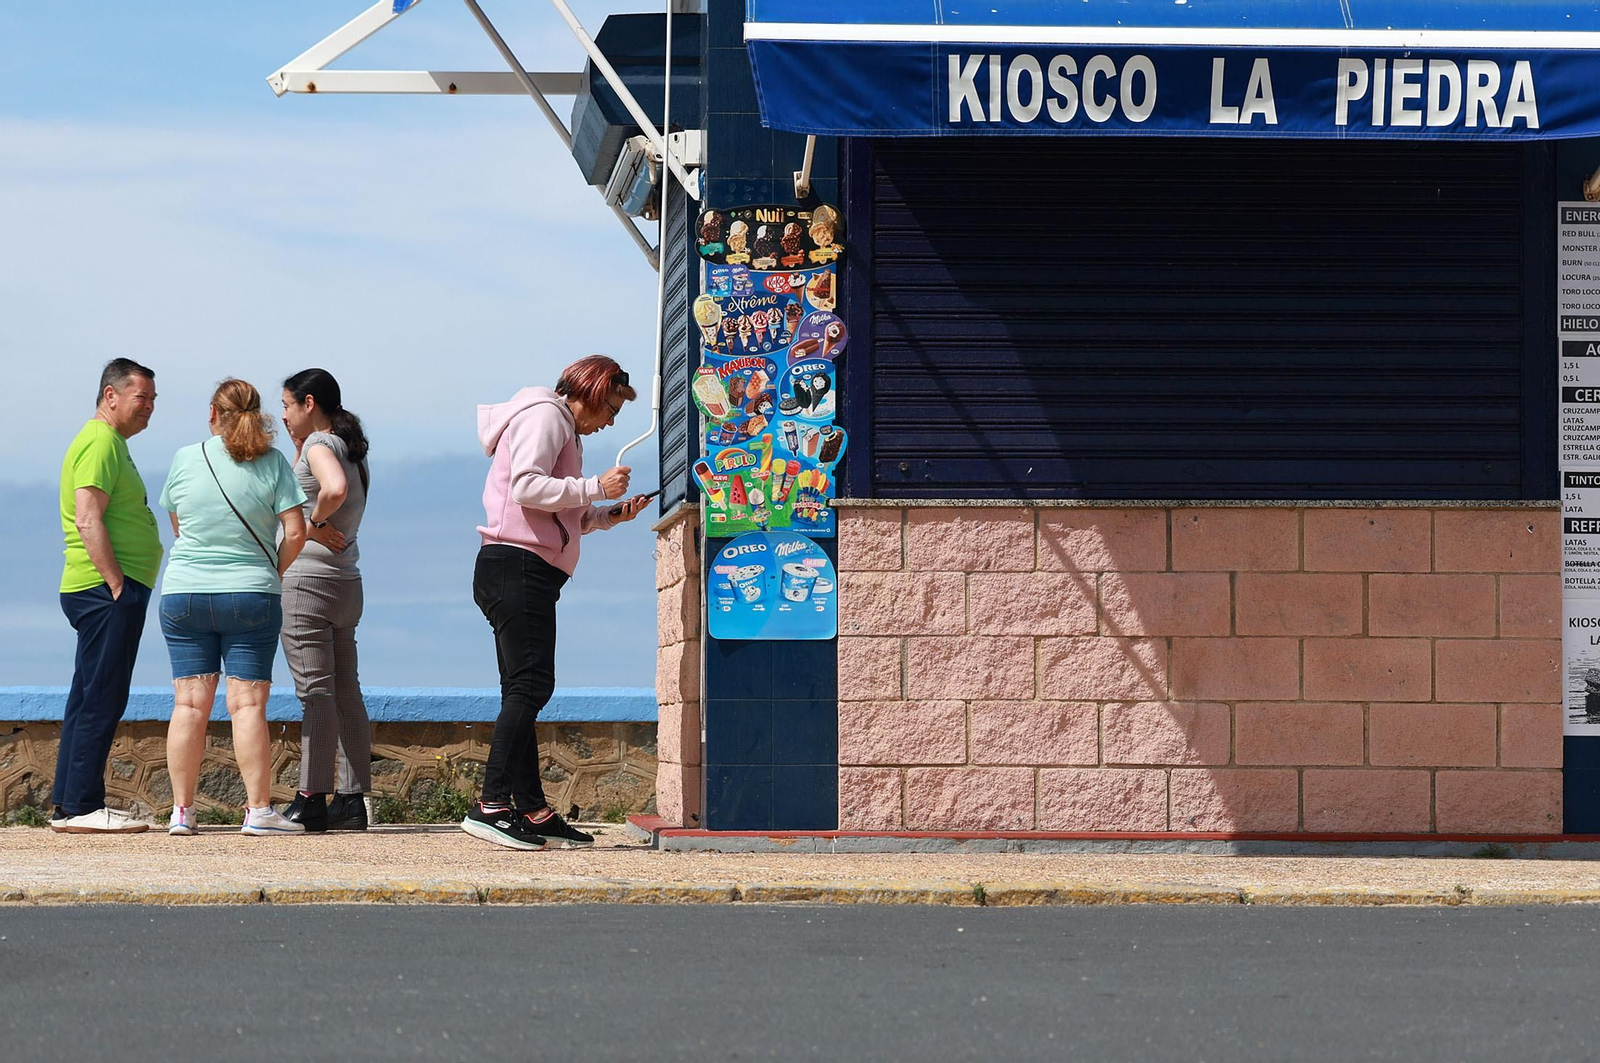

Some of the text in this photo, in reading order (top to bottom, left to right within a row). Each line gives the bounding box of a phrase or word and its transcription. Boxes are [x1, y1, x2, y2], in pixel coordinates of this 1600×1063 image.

[948, 54, 1539, 130] KIOSCO LA PIEDRA
[756, 208, 784, 222] Nuii
[1566, 211, 1600, 222] ENER
[1578, 230, 1595, 238] BULL
[1562, 244, 1597, 252] MONSTER
[1562, 259, 1582, 267] BURN
[1562, 302, 1581, 310] TORO
[809, 313, 832, 325] Milka
[1563, 318, 1599, 329] HIELO
[1586, 343, 1600, 356] A
[716, 357, 765, 381] MAXIBON
[791, 364, 826, 376] OREO
[1564, 362, 1574, 370] 1,5
[715, 454, 757, 473] PIRULO
[1566, 493, 1576, 501] 1,5
[723, 541, 807, 559] OREO Milka
[1565, 560, 1596, 568] BOTELLA
[1565, 577, 1596, 585] BOTELLA
